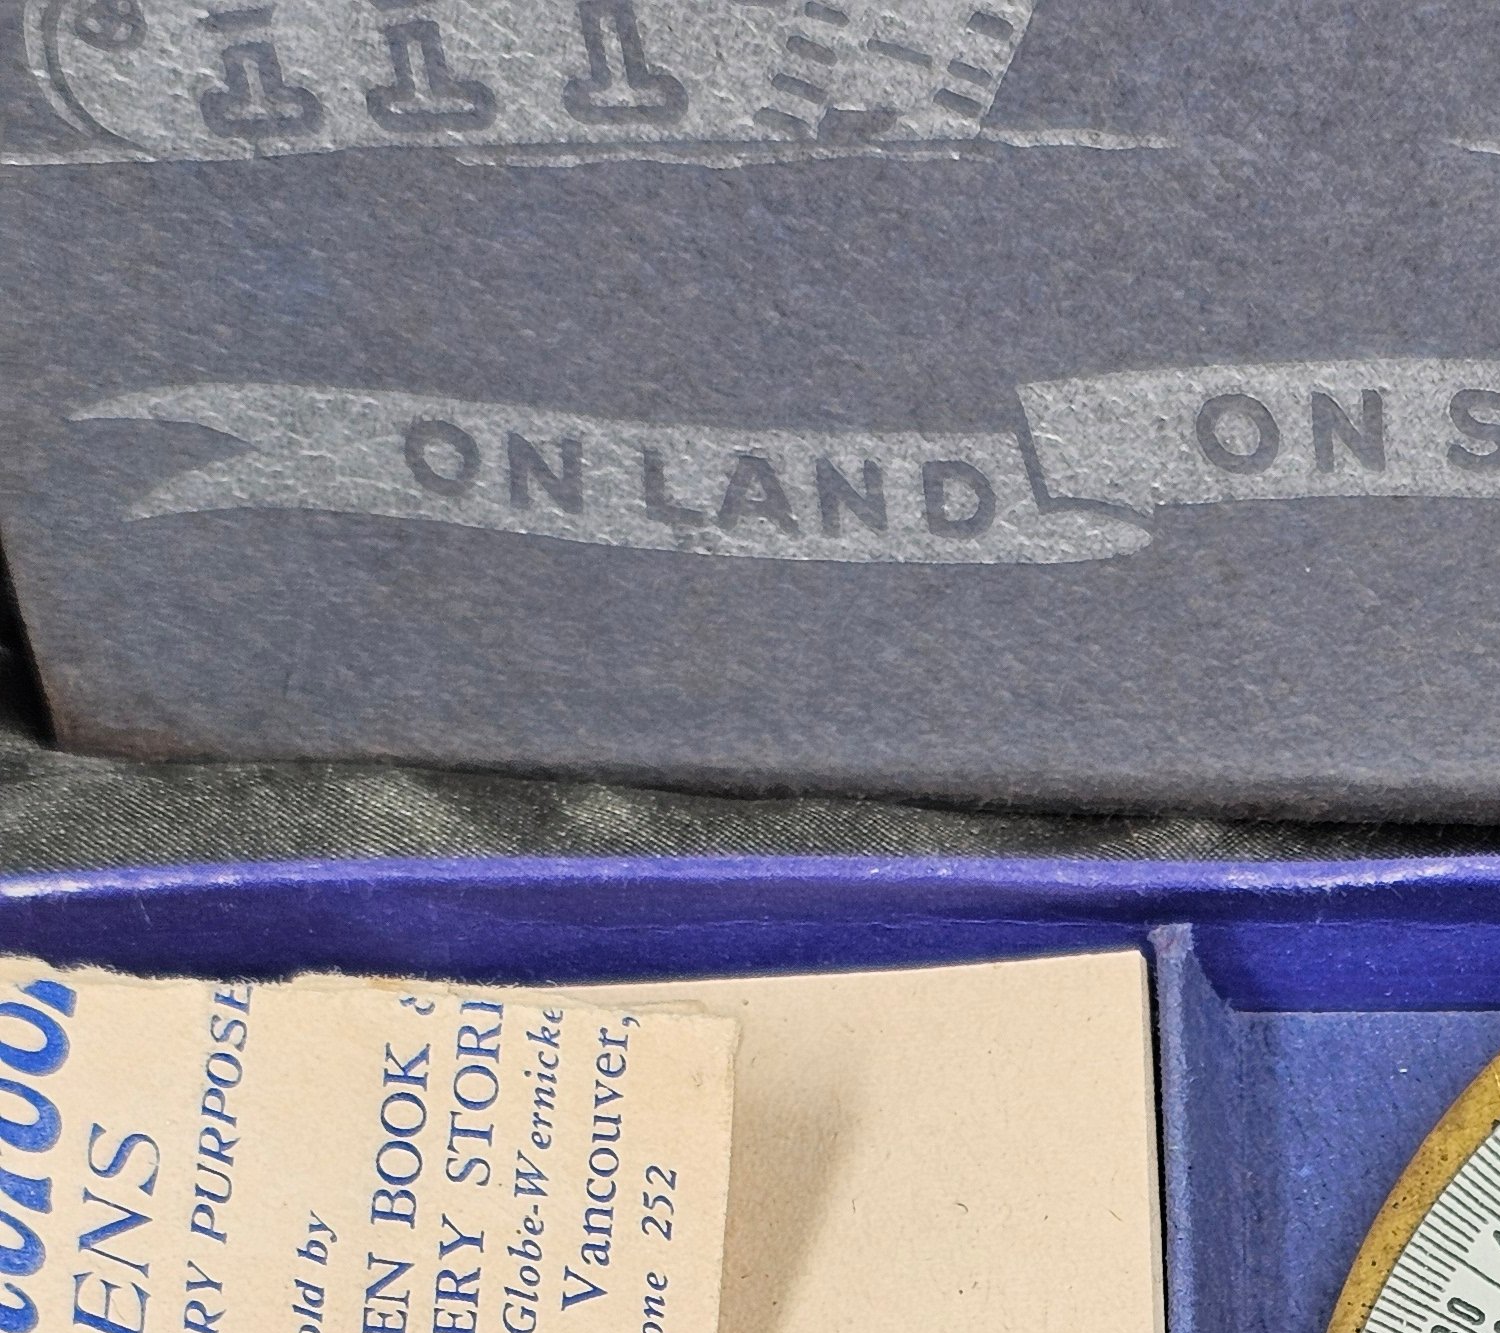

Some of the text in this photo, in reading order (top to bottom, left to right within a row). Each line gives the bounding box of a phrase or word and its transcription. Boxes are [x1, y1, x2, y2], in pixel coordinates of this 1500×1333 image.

[405, 418, 996, 539] ON LAND
[1198, 387, 1388, 475] ON
[370, 1042, 431, 1230] BOOK
[561, 1015, 641, 1313] Vancouver,
[296, 1209, 338, 1268] by
[642, 1165, 678, 1242] 252
